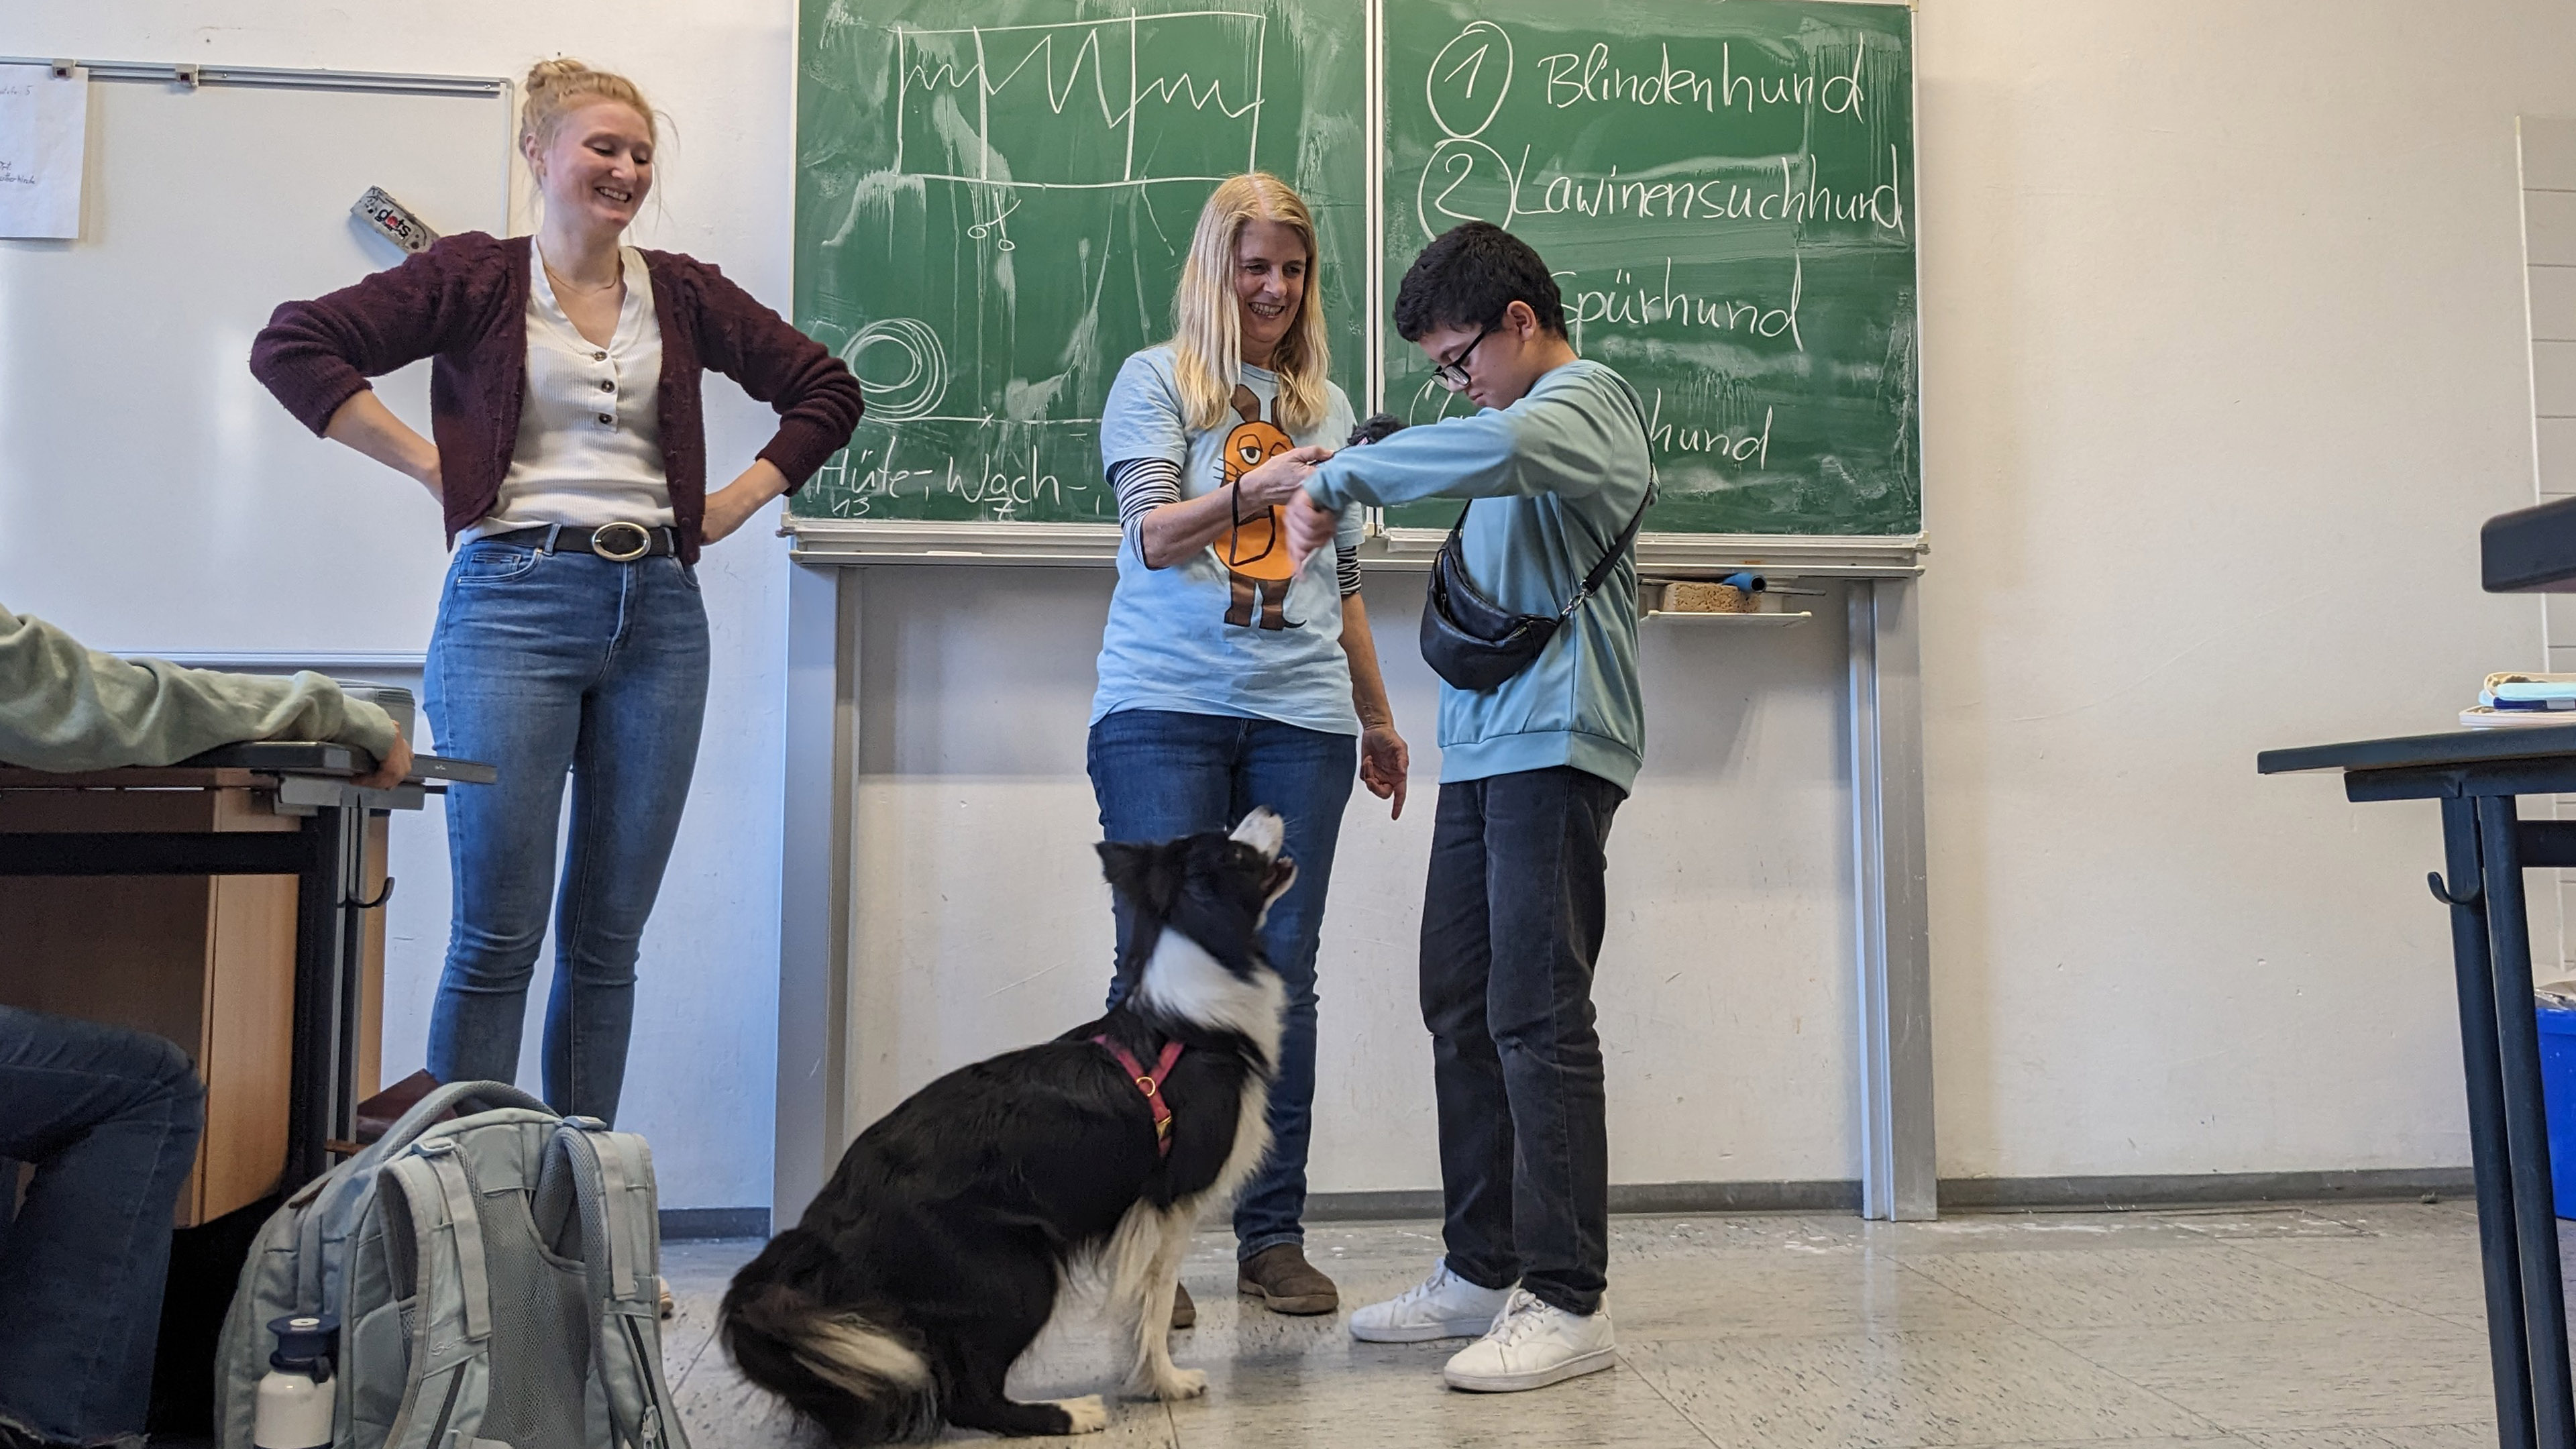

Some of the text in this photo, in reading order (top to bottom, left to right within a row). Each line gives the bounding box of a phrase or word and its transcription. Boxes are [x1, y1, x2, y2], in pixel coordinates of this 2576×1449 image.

[1444, 32, 1864, 123] 1 Blindenhund
[1434, 143, 1906, 238] 2 Lawinensuchhund
[1650, 387, 1774, 471] hund
